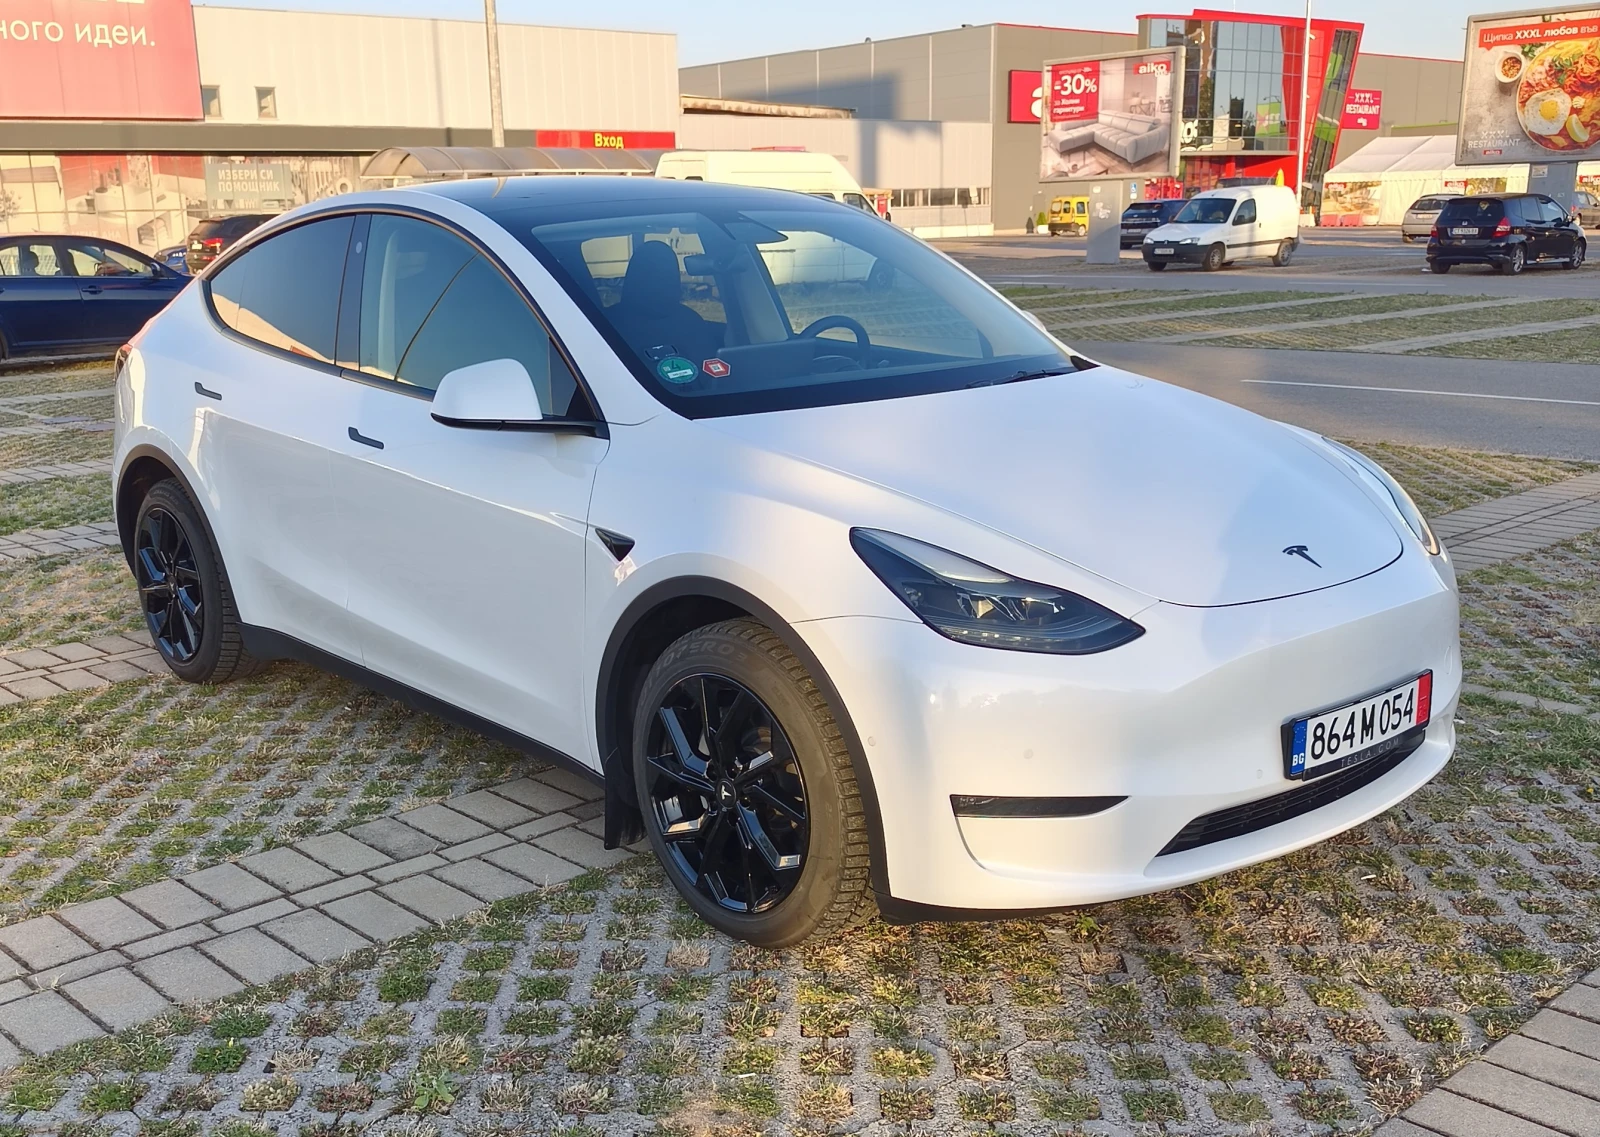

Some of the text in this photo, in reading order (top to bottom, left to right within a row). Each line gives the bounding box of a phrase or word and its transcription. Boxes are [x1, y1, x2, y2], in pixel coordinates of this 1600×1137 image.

[74, 23, 156, 48] идеи.
[1483, 33, 1513, 43] Щипка
[1515, 30, 1542, 40] XXXL
[1543, 26, 1579, 37] любов
[1138, 62, 1168, 74] aiko
[1054, 74, 1097, 95] -30%
[1346, 104, 1380, 115] RESTAURANT
[594, 132, 625, 150] Вход
[1481, 130, 1510, 139] XXXL
[1468, 138, 1521, 149] RESTAURANT
[218, 169, 274, 180] ИЗБЕРИ СИ
[218, 181, 281, 193] ПОМОЩНИК
[1292, 752, 1305, 767] BG
[1311, 711, 1356, 760] 864
[1360, 704, 1376, 744] M
[1379, 687, 1415, 735] 054
[1341, 738, 1400, 768] TESLA.COM
